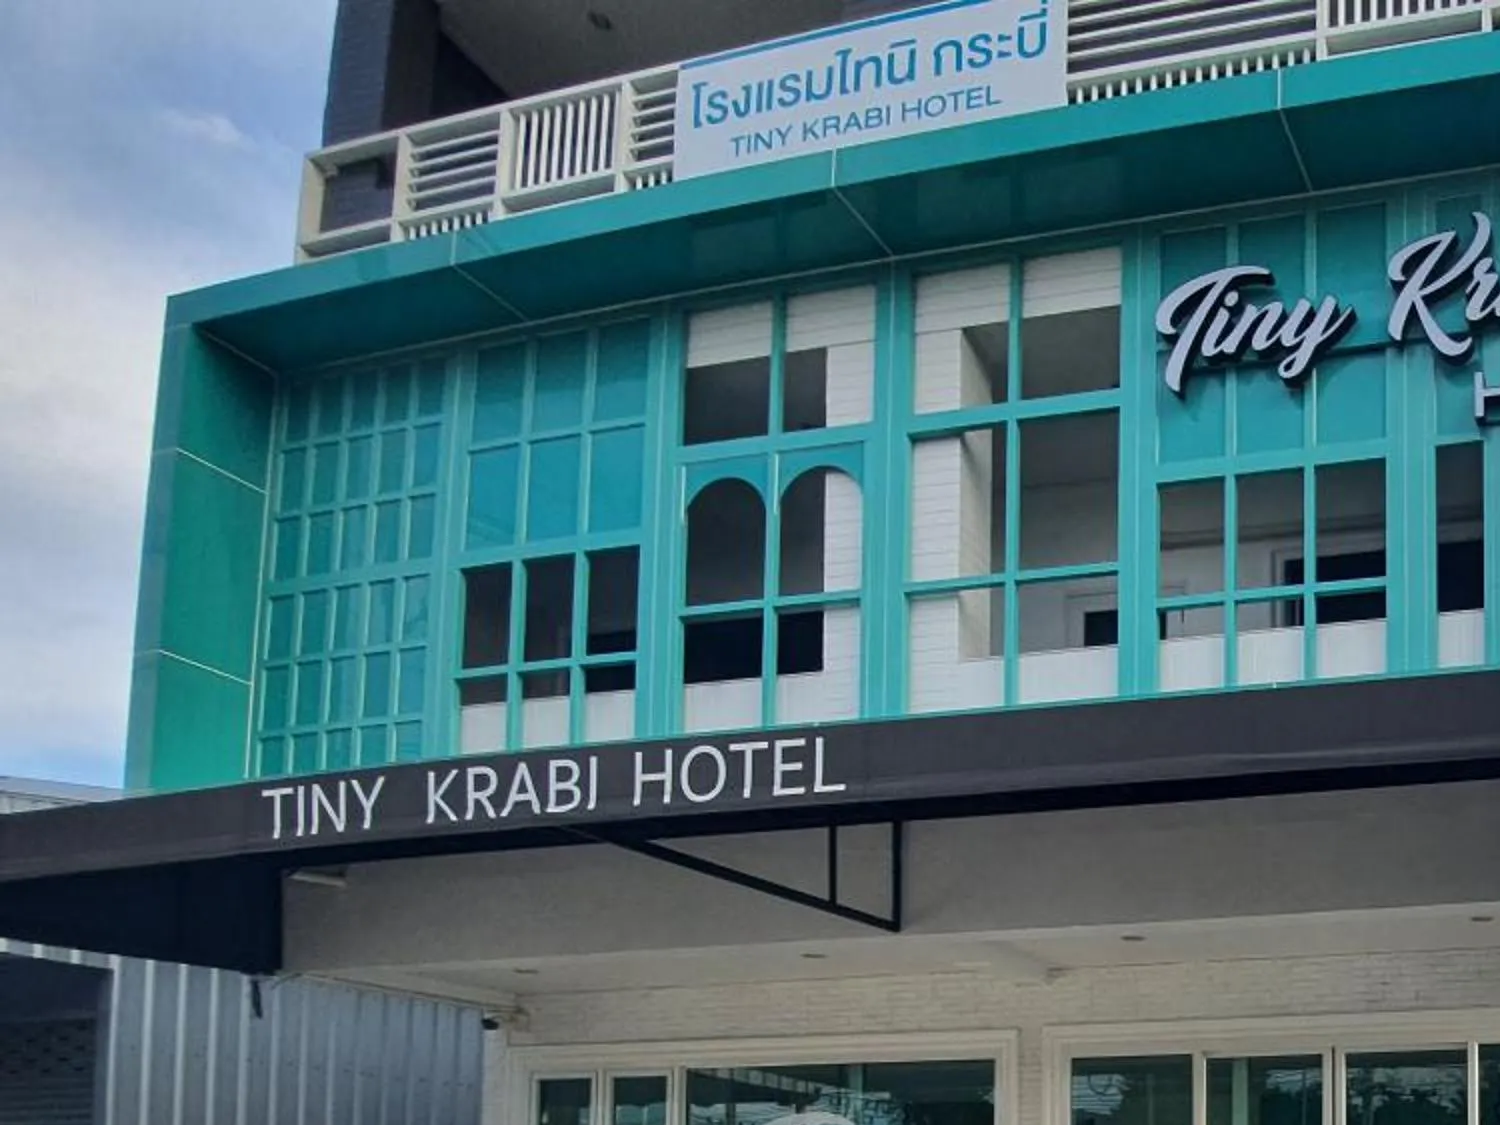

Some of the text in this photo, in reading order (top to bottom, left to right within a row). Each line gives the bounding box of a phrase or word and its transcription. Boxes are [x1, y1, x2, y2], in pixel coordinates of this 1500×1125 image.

[730, 85, 1003, 157] TINY KRABI HOTEL
[1155, 265, 1354, 393] Tiny
[261, 736, 847, 839] TINY KRABI HOTEL
